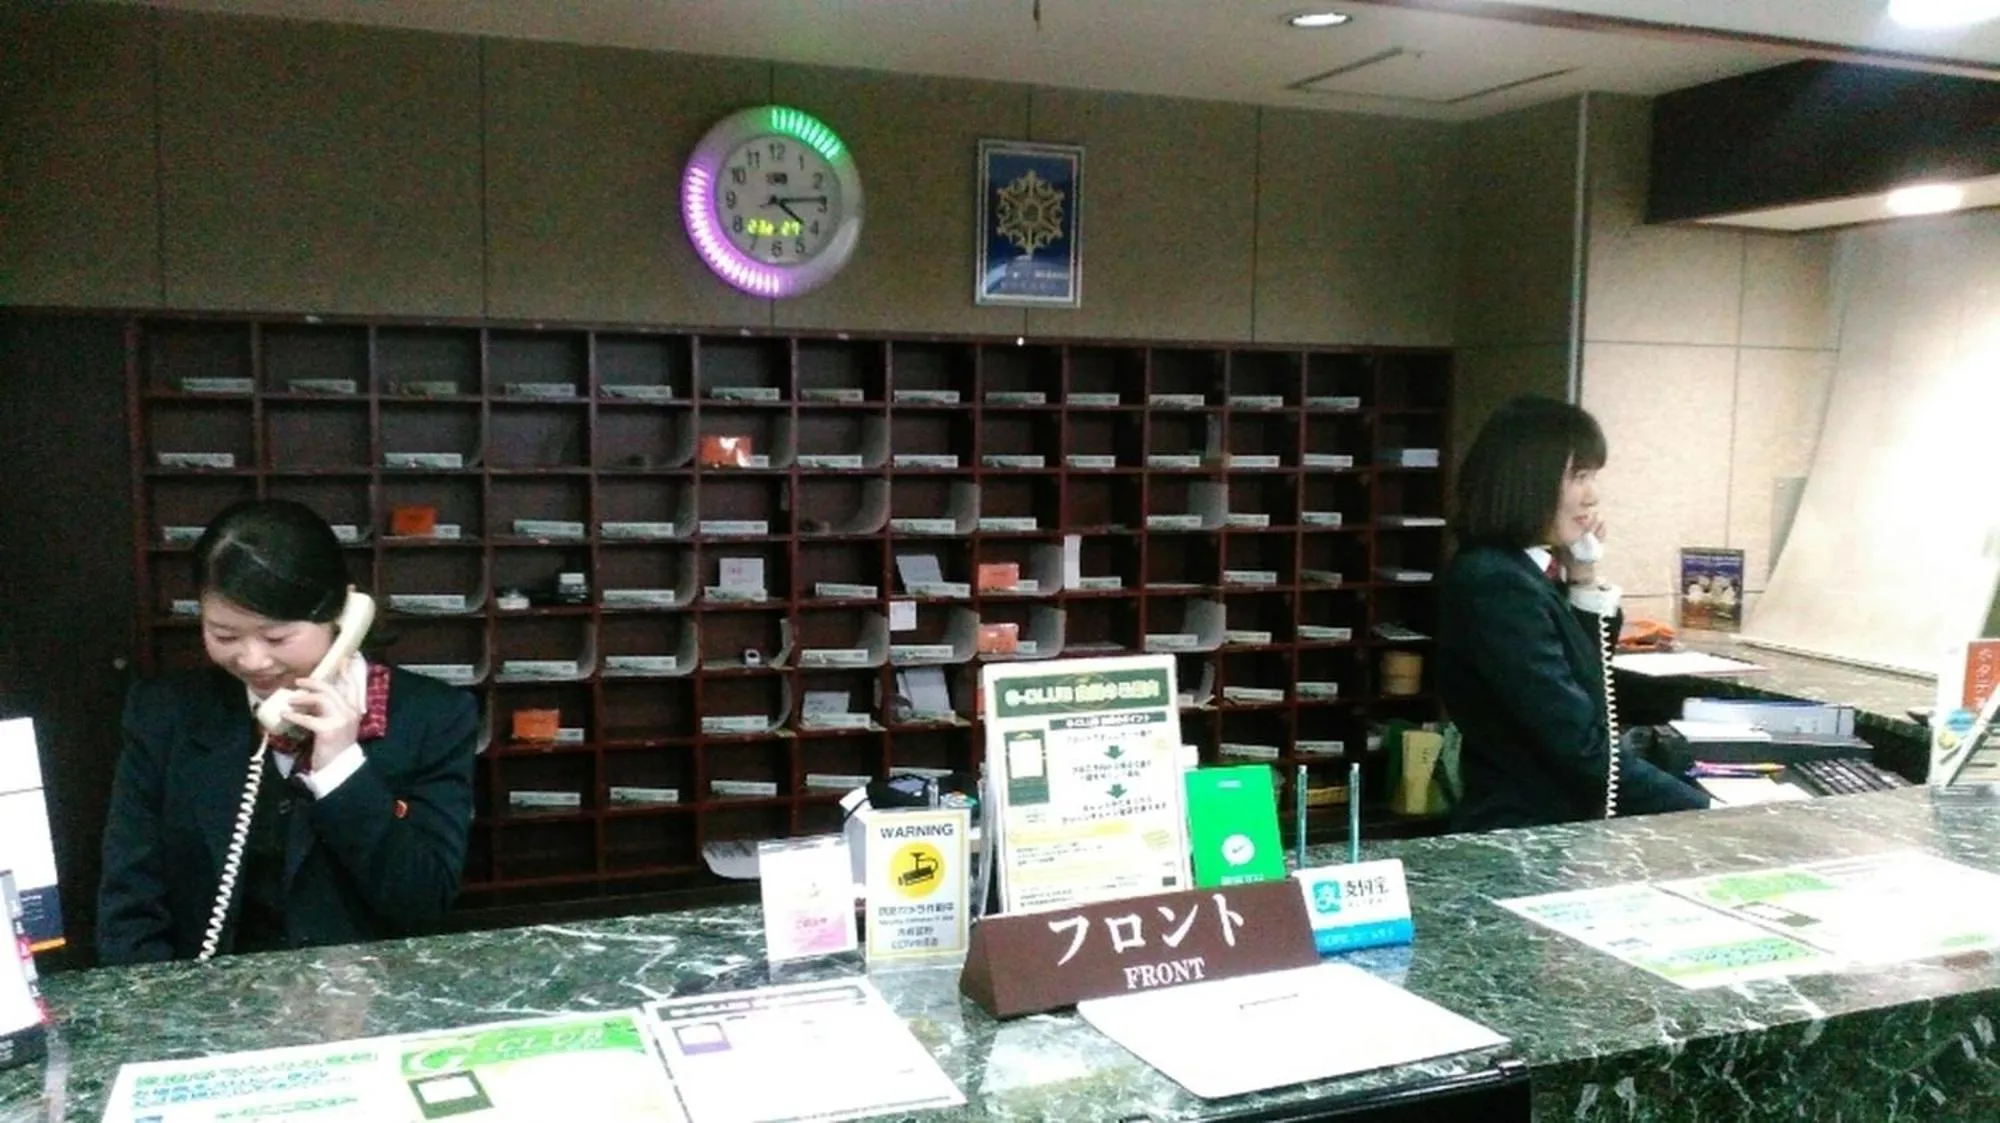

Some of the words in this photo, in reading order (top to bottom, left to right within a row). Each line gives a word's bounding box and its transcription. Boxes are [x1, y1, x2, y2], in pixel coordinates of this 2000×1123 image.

[746, 149, 760, 168] 11
[768, 142, 786, 160] 12
[798, 153, 805, 171] 1
[731, 167, 746, 185] 10
[812, 171, 824, 190] 2
[725, 190, 736, 210] 9
[732, 215, 743, 233] 8
[809, 220, 819, 236] 4
[771, 240, 783, 258] 6
[794, 236, 805, 254] 5
[880, 823, 954, 839] WARNING
[1048, 893, 1244, 966] フロント
[1123, 957, 1205, 989] FRONT
